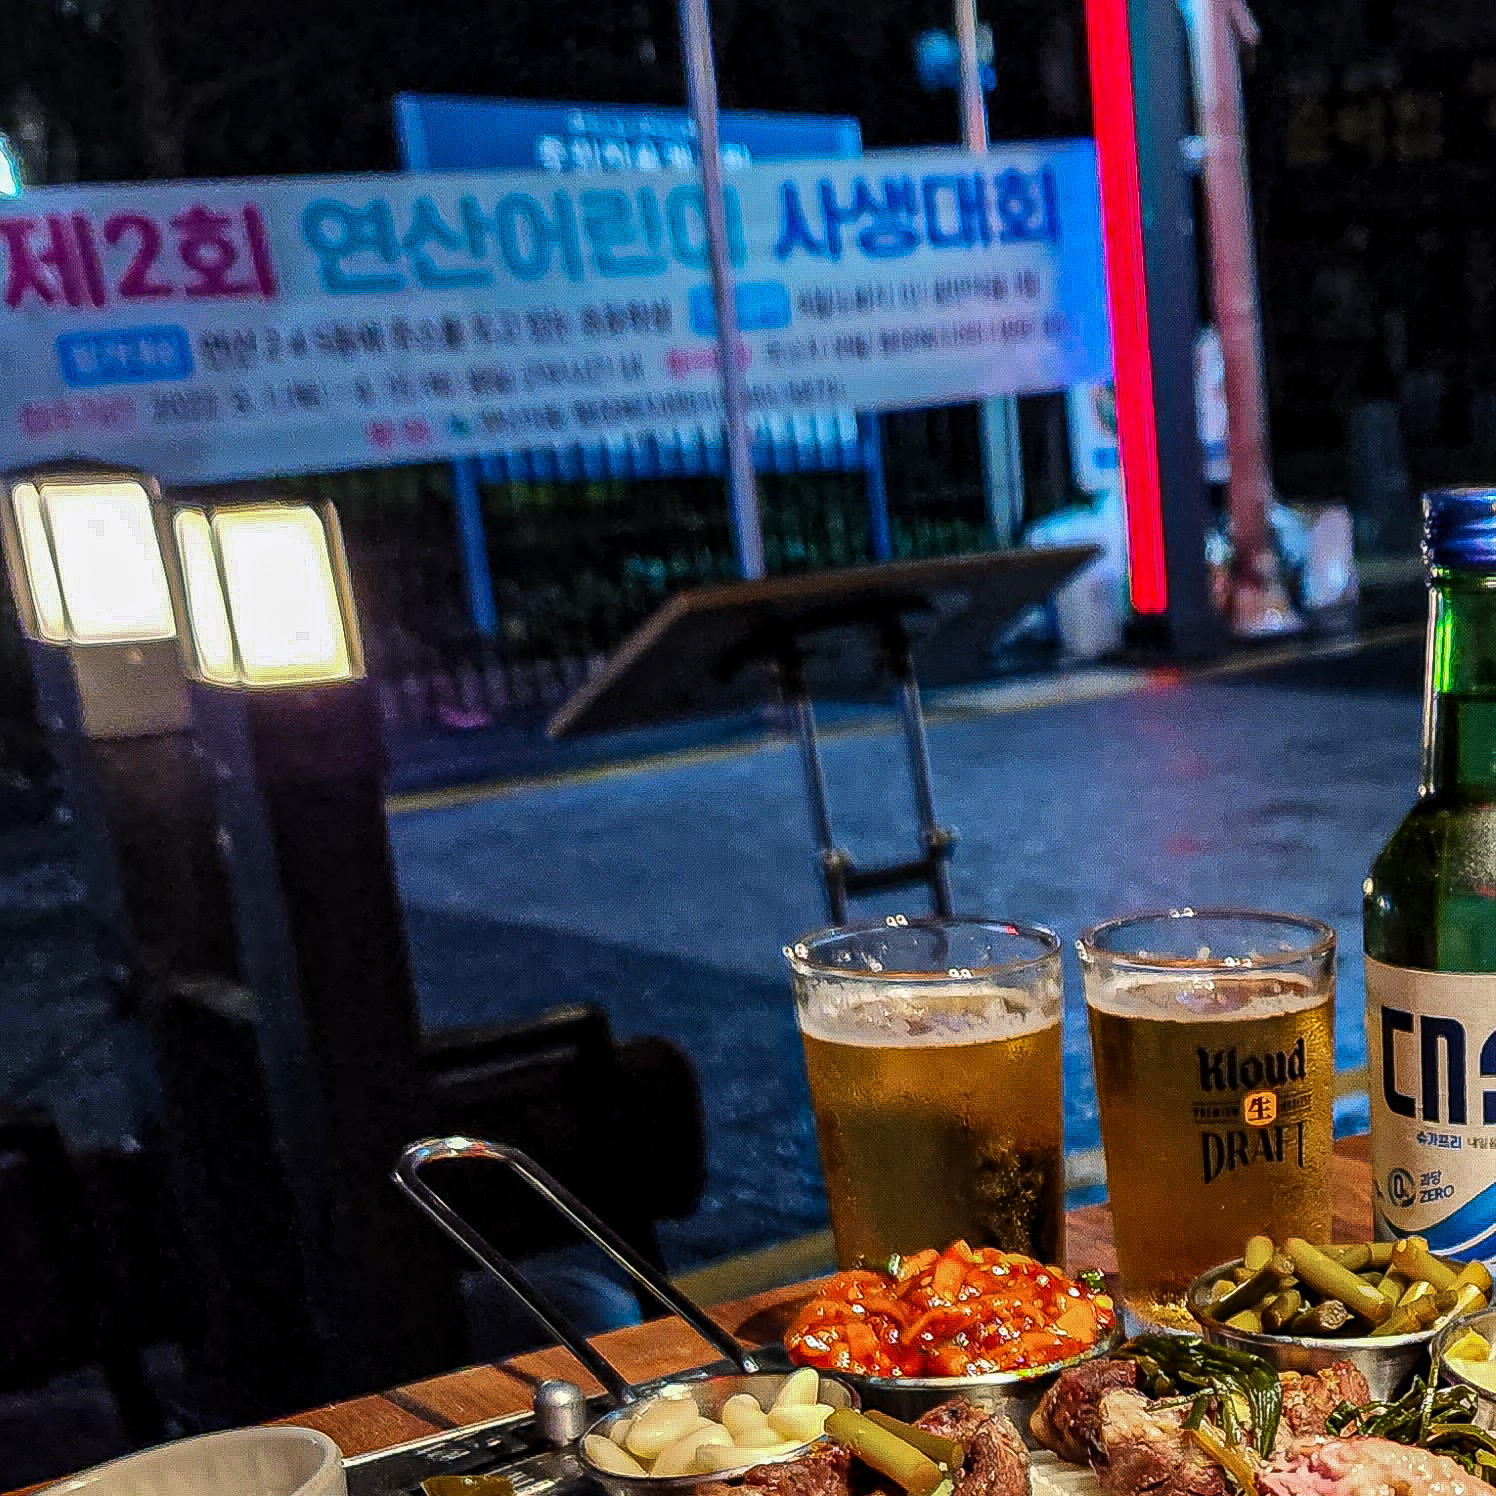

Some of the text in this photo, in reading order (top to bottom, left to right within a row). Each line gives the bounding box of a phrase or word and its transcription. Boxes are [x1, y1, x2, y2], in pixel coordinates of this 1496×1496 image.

[0, 204, 278, 308] 제2회
[302, 186, 746, 295] 연산어린이
[775, 165, 1062, 262] 사생대회
[1197, 1036, 1306, 1092] Kloud
[1201, 1121, 1304, 1185] DRAFT
[1419, 1184, 1455, 1203] ZERO
